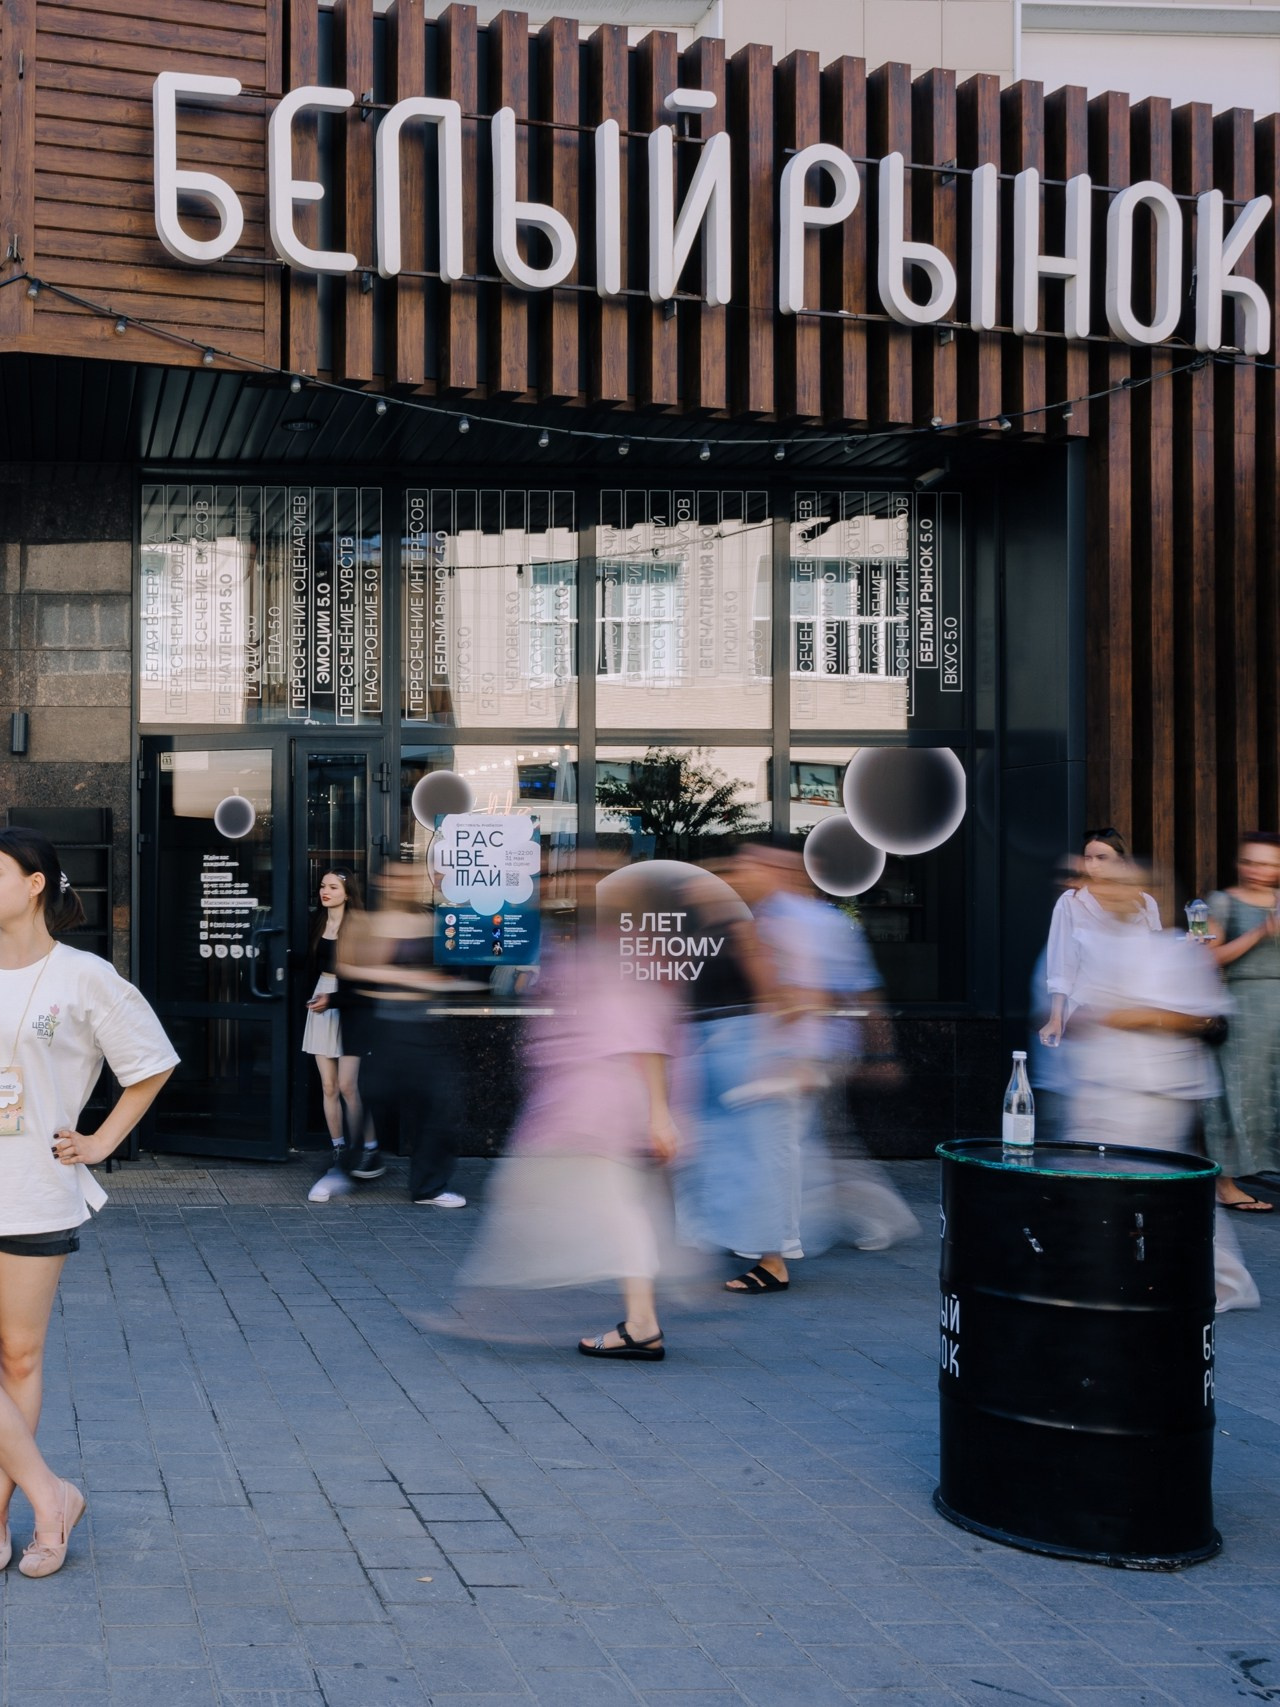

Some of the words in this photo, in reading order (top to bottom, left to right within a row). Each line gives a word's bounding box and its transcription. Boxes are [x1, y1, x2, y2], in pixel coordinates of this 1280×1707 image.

[153, 71, 732, 307] БЕЛЫЙ
[779, 143, 1272, 356] РЫНОК
[196, 500, 209, 564] ВКУСОВ
[293, 495, 308, 591] СЦЕНАРИЕВ
[410, 497, 424, 593] ИНТЕРЕСОВ
[435, 530, 448, 554] 5.0
[920, 518, 933, 542] 5.0
[168, 532, 185, 590] ЛЮДЕЙ
[220, 574, 232, 597] 5.0
[340, 537, 354, 600] ЧУВСТВ
[364, 568, 378, 591] 5.0
[435, 558, 448, 612] РЫНОК
[920, 546, 933, 602] РЫНОК
[269, 606, 282, 629] 5.0
[317, 583, 330, 607] 5.0
[699, 554, 714, 669] ВПЕЧАТЛЕНИЯ
[170, 595, 183, 708] ПЕРЕСЕЧЕНИЕ
[195, 569, 208, 683] ПЕРЕСЕЧЕНИЕ
[268, 633, 283, 664] ЕДА
[293, 595, 306, 709] ПЕРЕСЕЧЕНИЕ
[316, 610, 332, 684] ЭМОЦИИ
[364, 595, 378, 703] НАСТРОЕНИЕ
[432, 618, 448, 675] БЕЛЫЙ
[917, 606, 934, 662] БЕЛЫЙ
[944, 617, 957, 640] 5.0
[146, 630, 159, 682] БЕЛАЯ
[219, 602, 232, 716] ВПЕЧАТЛЕНИЯ
[243, 642, 259, 692] ЛЮДИ
[340, 604, 354, 717] ПЕРЕСЕЧЕНИЕ
[410, 598, 424, 711] ПЕРЕСЕЧЕНИЕ
[458, 652, 471, 693] ВКУС
[506, 617, 519, 690] ЧЕЛОВЕК
[944, 643, 957, 684] ВКУС
[441, 850, 489, 869] ЦВЕ
[456, 831, 503, 847] РАС
[456, 865, 501, 886] ТАЙ
[619, 937, 724, 957] БЕЛОМУ
[620, 913, 633, 932] 5
[639, 913, 687, 932] ЛЕТ
[620, 962, 704, 981] РЫНКУ
[38, 1015, 56, 1023] РАС
